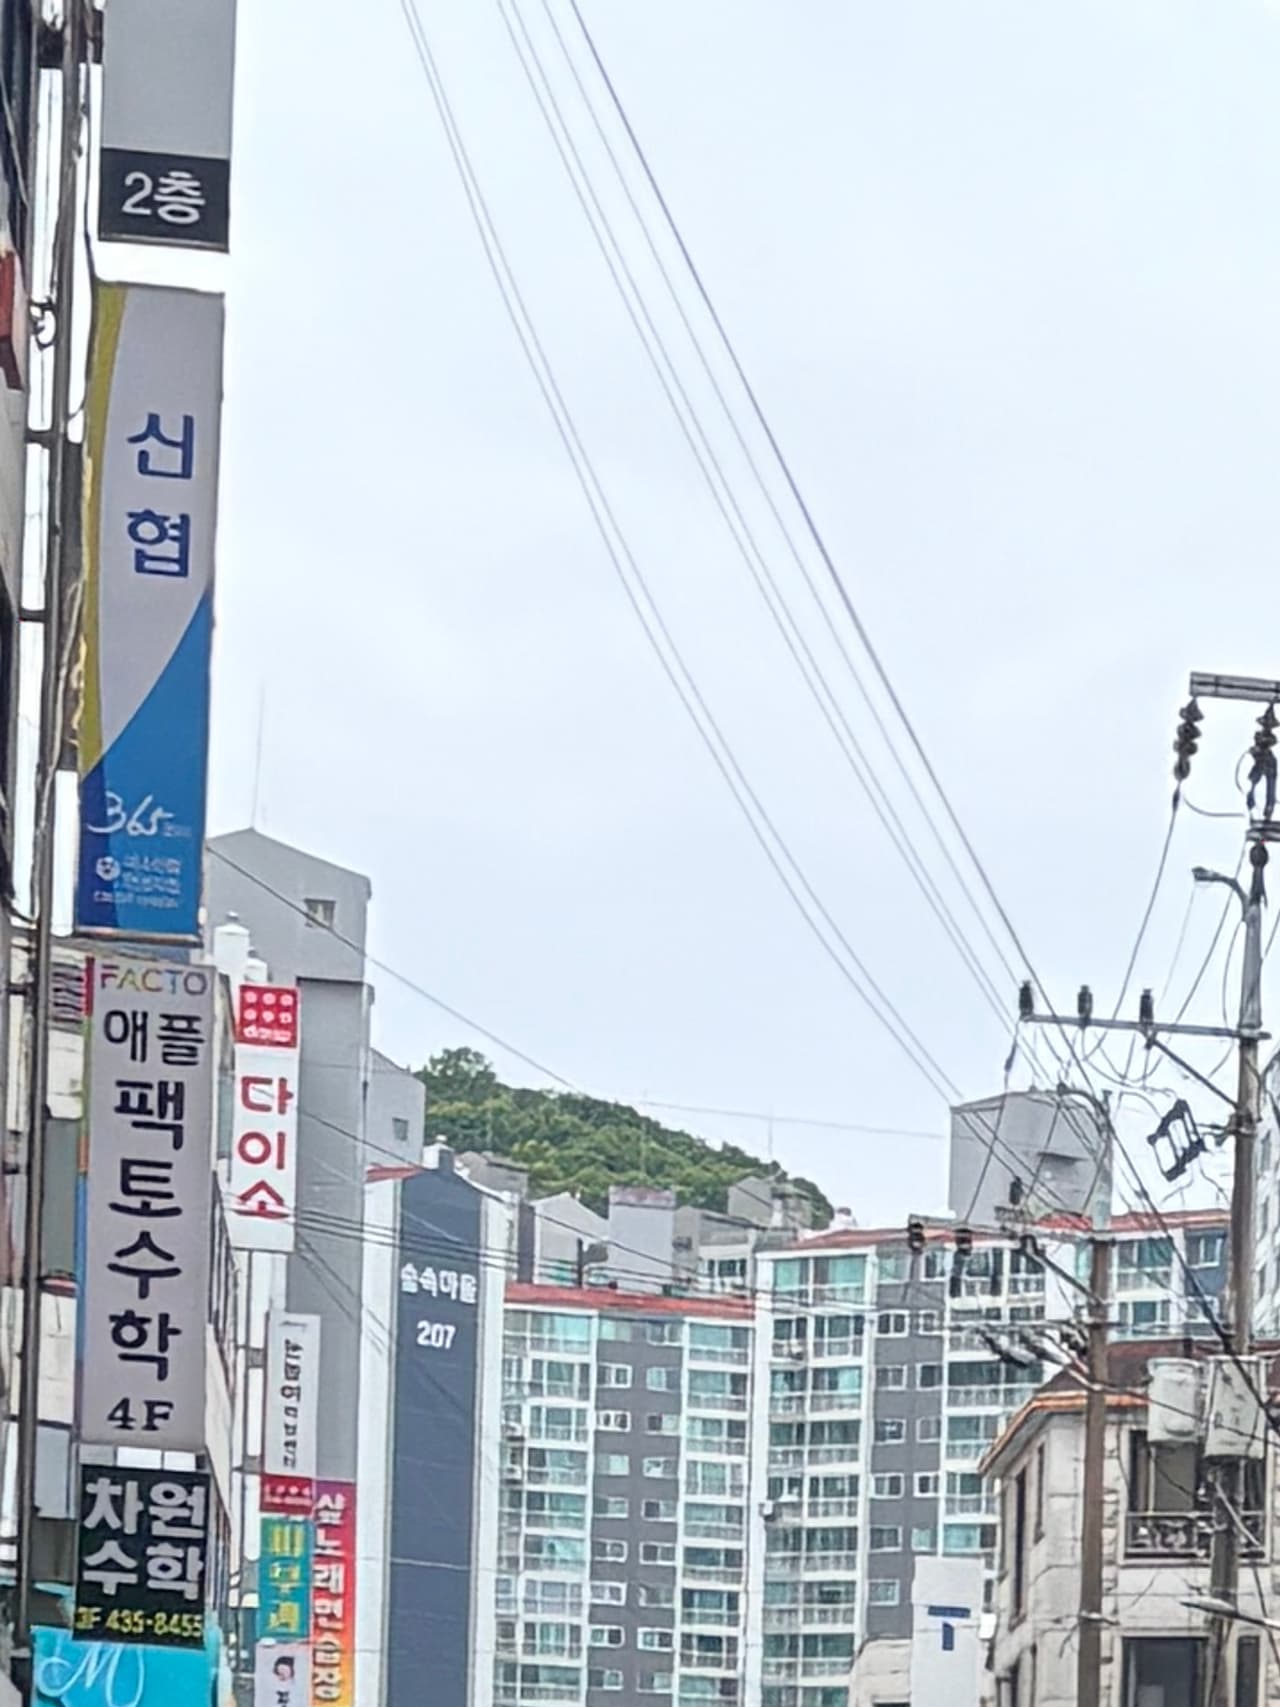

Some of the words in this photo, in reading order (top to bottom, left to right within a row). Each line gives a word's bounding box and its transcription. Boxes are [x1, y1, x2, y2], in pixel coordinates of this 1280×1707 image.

[121, 170, 206, 225] 2층
[125, 410, 197, 580] 신협
[101, 962, 209, 995] FACTO
[104, 1008, 206, 1067] 애플
[237, 1074, 295, 1221] 다이소
[106, 1078, 187, 1383] 팩토수학
[417, 1319, 456, 1350] 207
[106, 1396, 176, 1433] 4F
[83, 1479, 207, 1539] 차원
[83, 1541, 207, 1602] 수학
